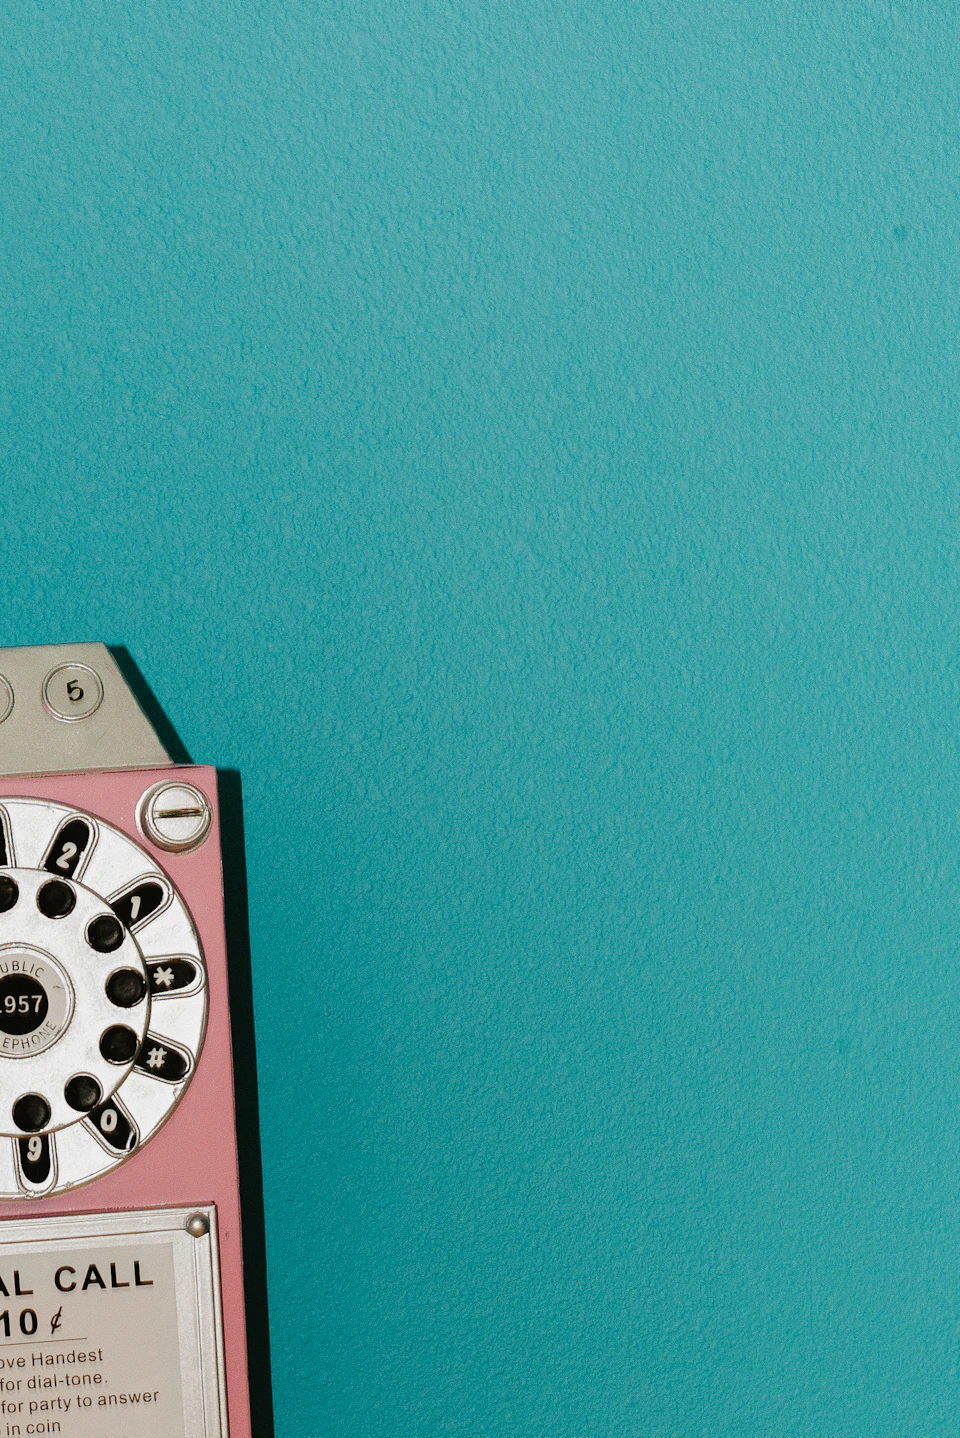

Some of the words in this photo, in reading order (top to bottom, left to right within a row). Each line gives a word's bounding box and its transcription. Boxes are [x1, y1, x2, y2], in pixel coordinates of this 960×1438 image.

[67, 680, 84, 701] 5
[56, 842, 76, 868] 2
[130, 895, 142, 918] 1
[26, 1134, 43, 1161] 9
[53, 1260, 155, 1293] CALL
[50, 1306, 63, 1334] ¢
[31, 1348, 104, 1367] Handest
[0, 1376, 22, 1391] for
[26, 1370, 109, 1390] dial-tone.
[1, 1399, 23, 1414] for
[29, 1394, 72, 1415] party
[76, 1393, 93, 1408] to
[97, 1390, 160, 1406] answer
[6, 1422, 22, 1437] in
[26, 1419, 62, 1435] coin
